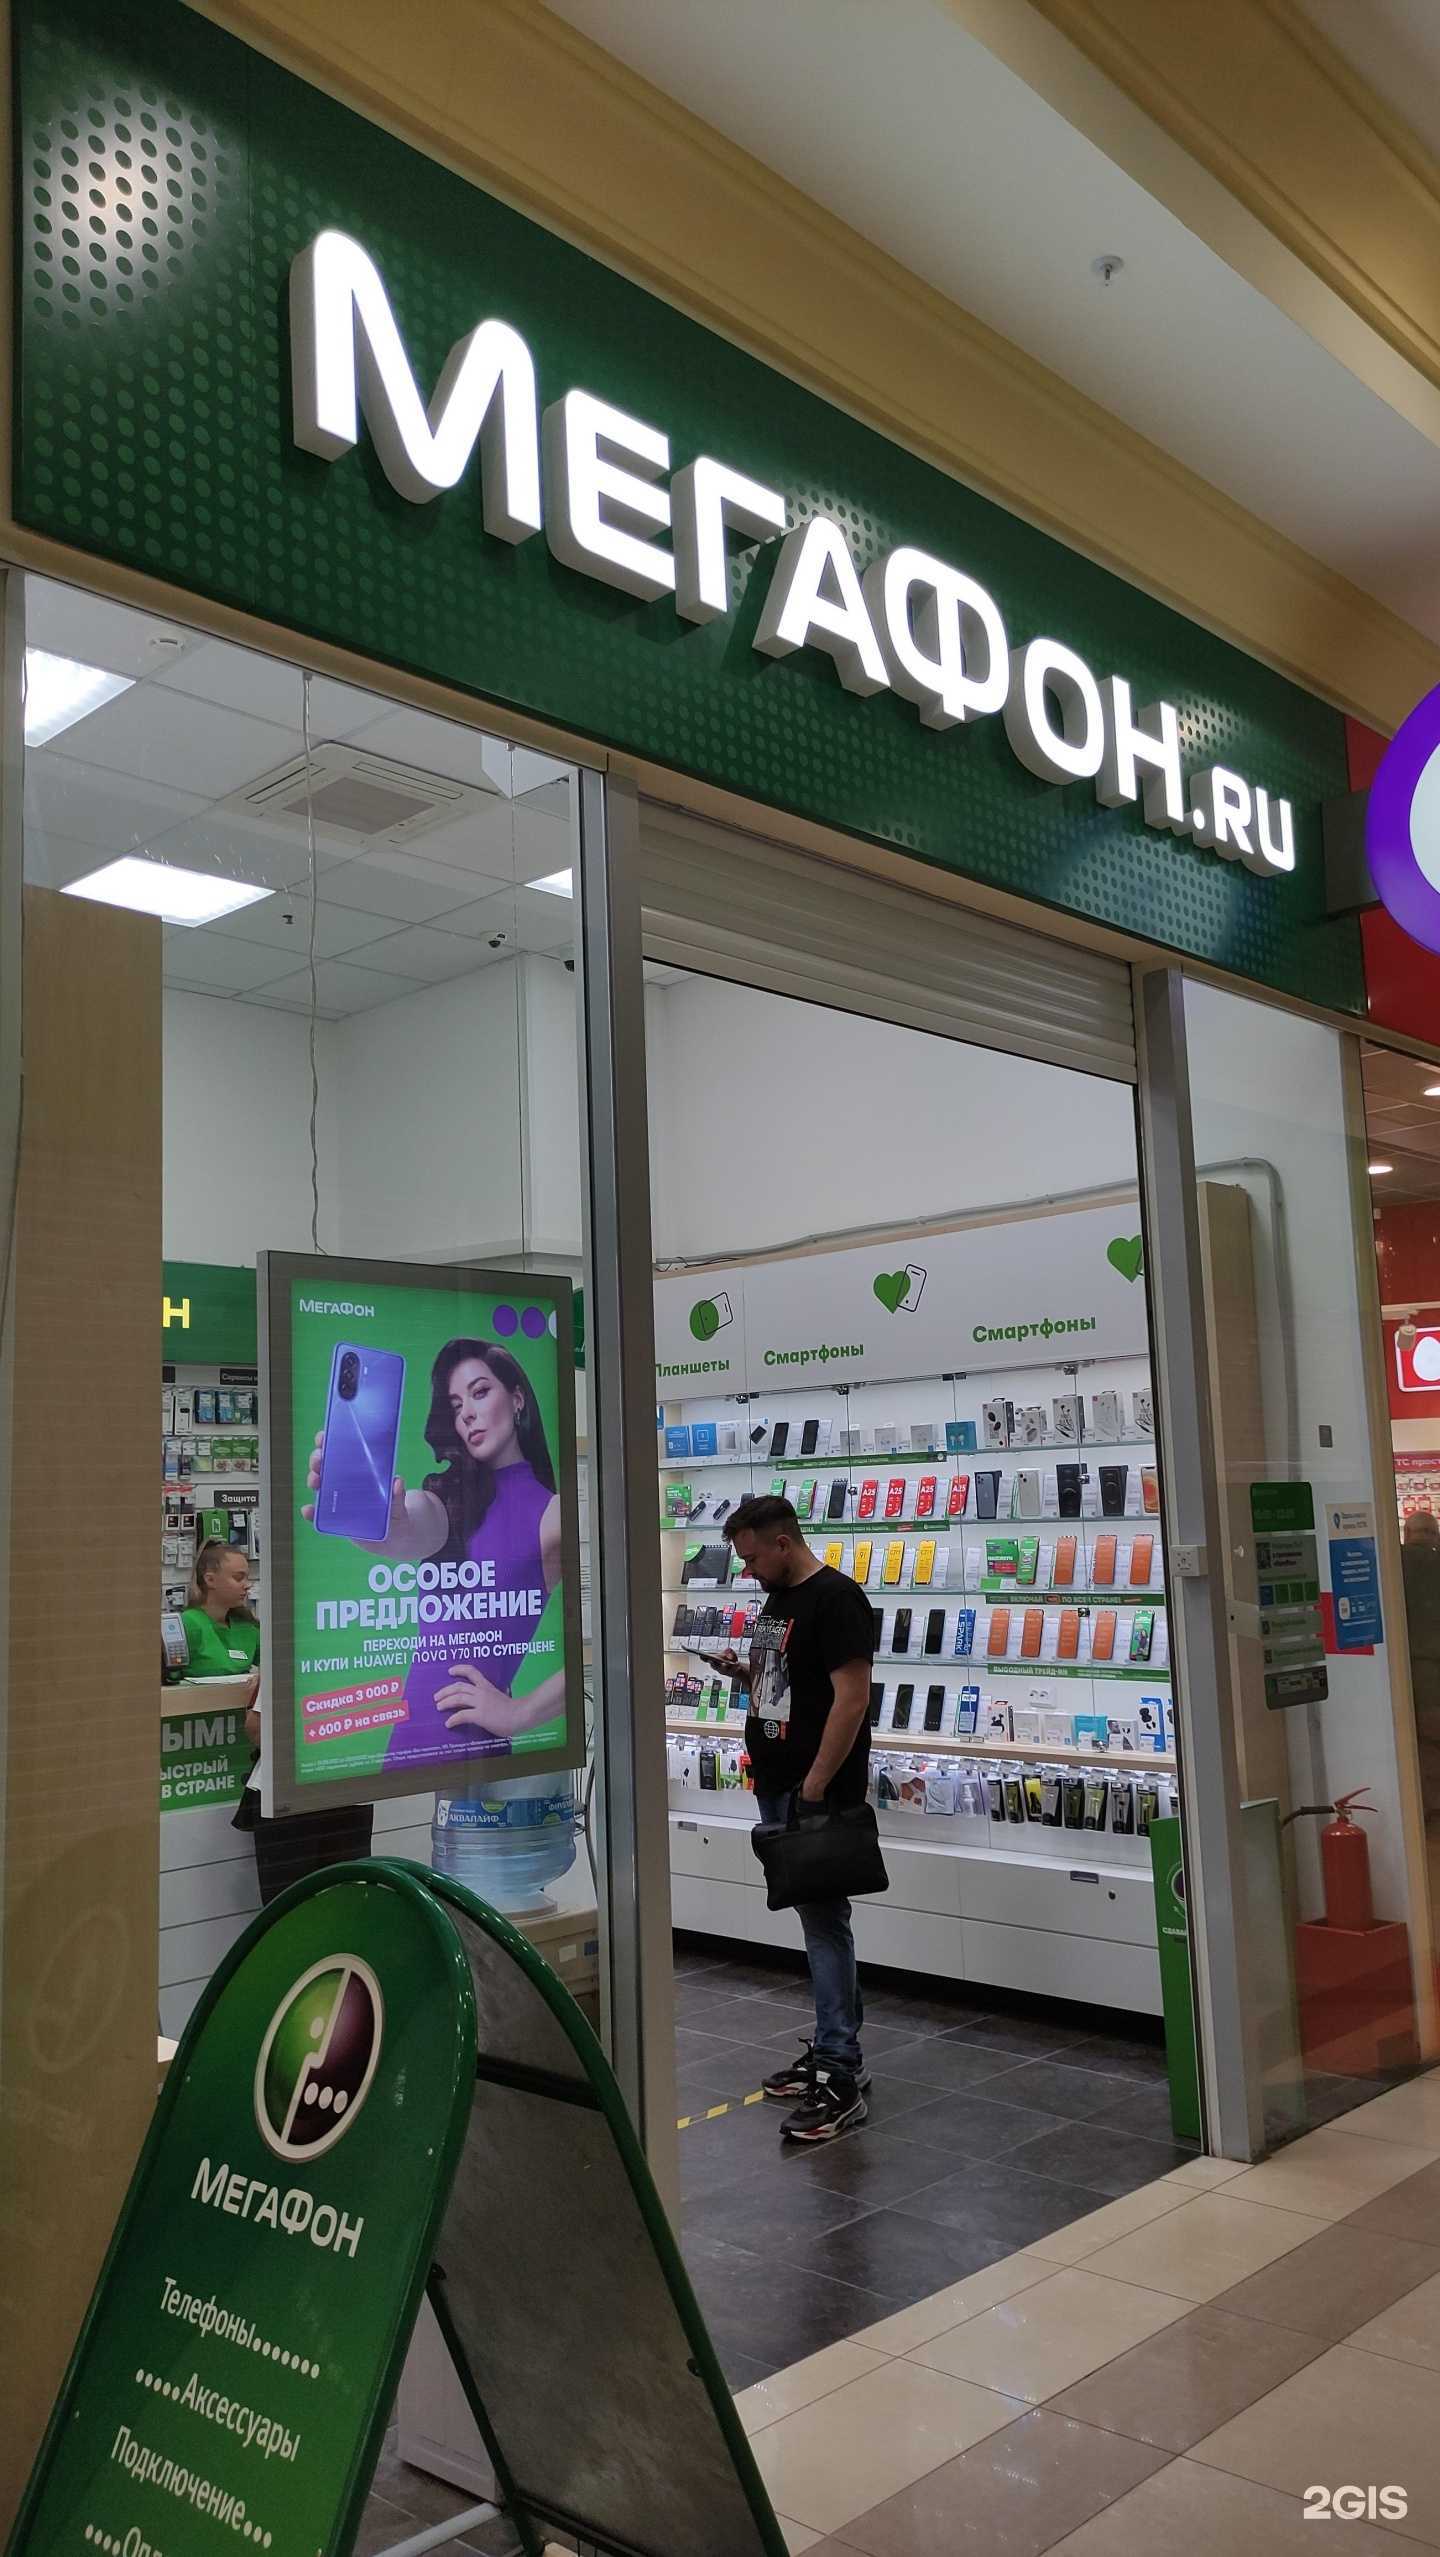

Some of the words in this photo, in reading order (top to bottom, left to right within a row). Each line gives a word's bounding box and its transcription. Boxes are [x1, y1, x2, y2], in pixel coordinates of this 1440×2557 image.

[162, 1297, 190, 1329] Н
[972, 1316, 1096, 1343] Смартфоны
[763, 1343, 864, 1367] Смартфоны
[222, 1494, 257, 1504] Защита
[368, 1560, 496, 1593] ОСОБОЕ
[316, 1589, 542, 1631] ПРЕДЛОЖЕНИЕ
[363, 1635, 426, 1652] ПЕРЕХОДИ
[430, 1634, 446, 1647] НА
[448, 1630, 503, 1645] МЕГАФОН
[301, 1660, 310, 1674] И
[314, 1656, 349, 1672] КУПИ
[354, 1652, 407, 1668] HUAWEI
[412, 1649, 447, 1664] nova
[450, 1647, 471, 1661] Y70
[473, 1645, 490, 1658] ПО
[493, 1640, 556, 1656] СУПЕРЦЕНЕ
[306, 1694, 354, 1712] Скидка
[355, 1690, 364, 1701] 3
[365, 1684, 389, 1698] 000
[318, 1721, 342, 1736] 600
[355, 1717, 370, 1727] на
[372, 1708, 406, 1723] связь
[161, 1784, 172, 1799] В
[175, 1775, 235, 1796] СТРАНЕ
